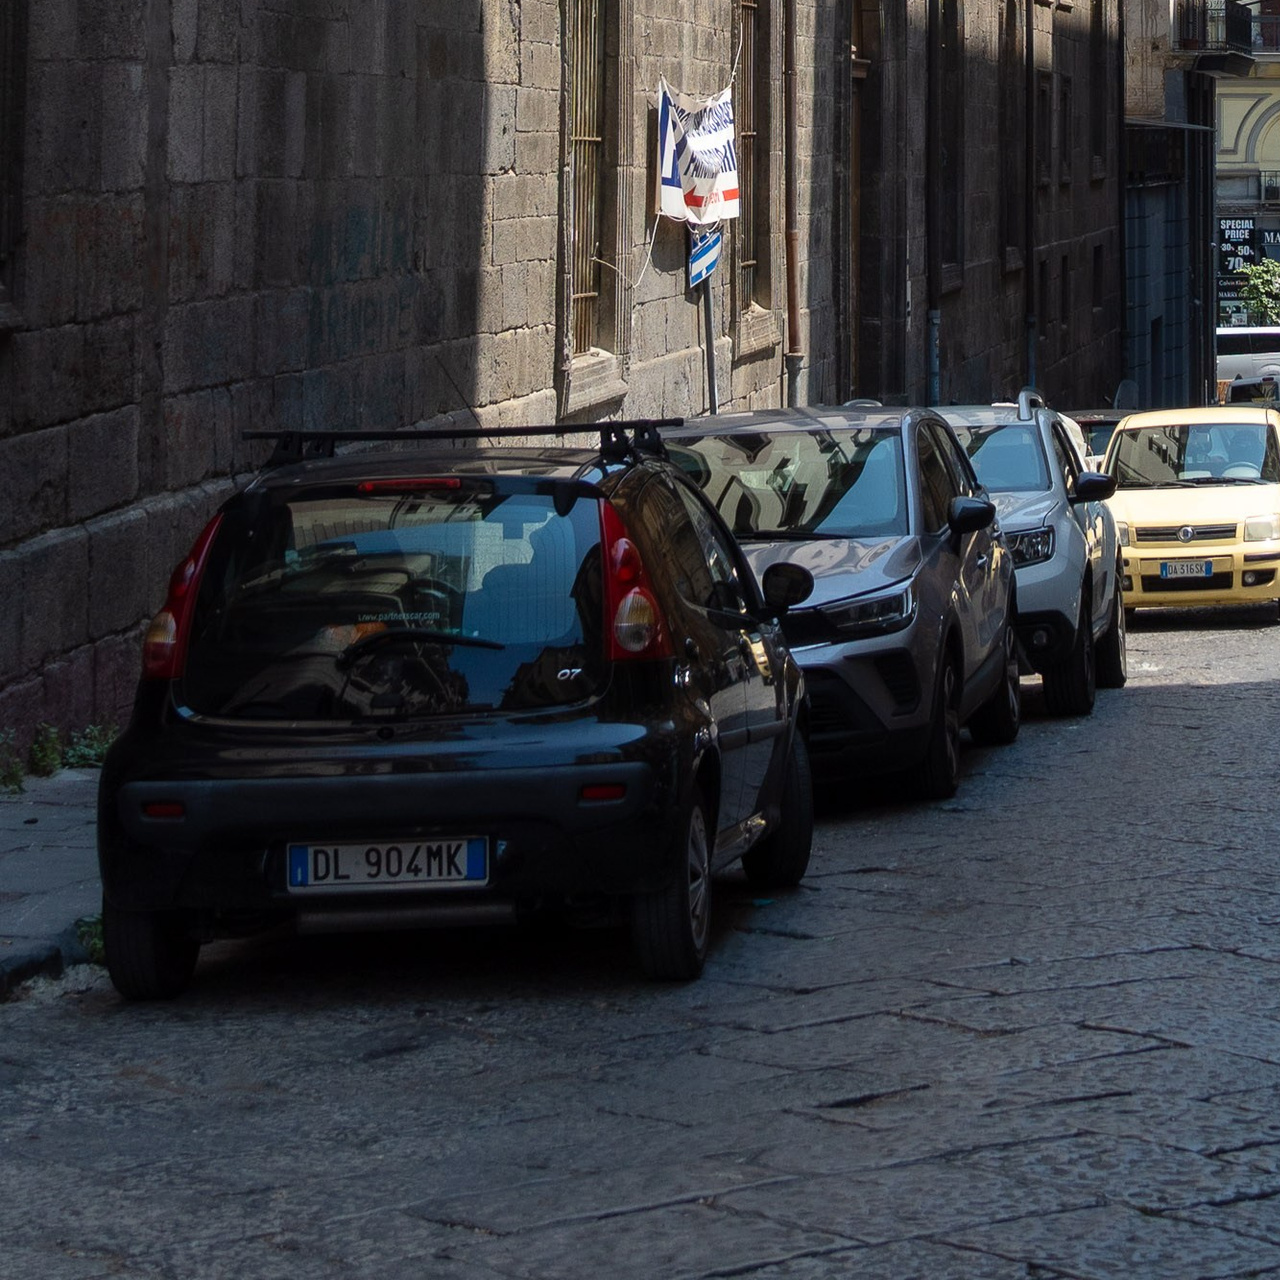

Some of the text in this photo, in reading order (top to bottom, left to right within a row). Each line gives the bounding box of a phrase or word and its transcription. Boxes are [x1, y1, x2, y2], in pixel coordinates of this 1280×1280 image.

[1220, 219, 1254, 229] SPECIAL
[1224, 229, 1250, 239] PRICE
[1236, 245, 1254, 256] -50%
[313, 848, 350, 881] DL
[364, 843, 463, 879] 904MK
